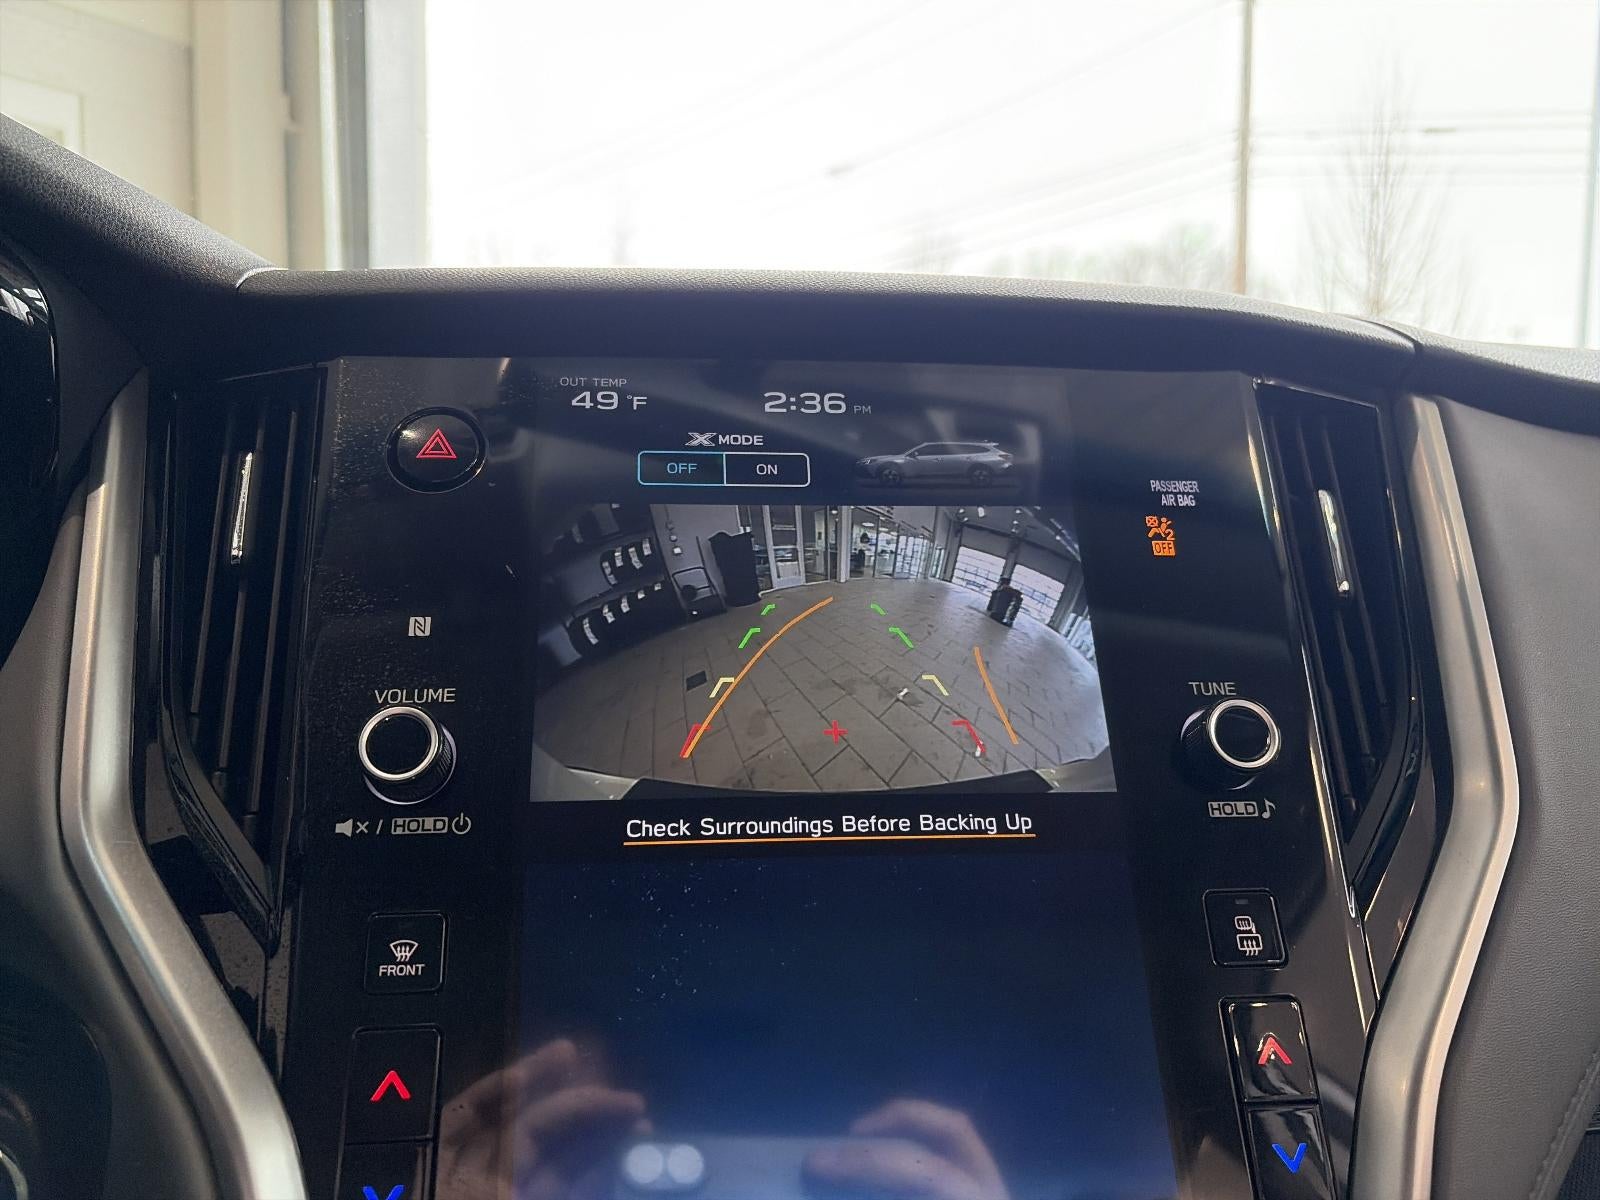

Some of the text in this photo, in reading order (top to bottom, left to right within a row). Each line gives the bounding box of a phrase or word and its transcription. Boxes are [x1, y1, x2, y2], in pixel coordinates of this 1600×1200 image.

[560, 377, 627, 387] OUT TEMP
[571, 391, 619, 410] 49
[763, 391, 872, 415] 2:36 PM
[718, 434, 764, 446] MODE
[666, 462, 698, 475] OFF
[756, 463, 778, 476] ON
[1150, 480, 1200, 493] PASSENGER
[1161, 494, 1196, 506] AIR BAG
[1154, 542, 1174, 554] OFF
[1188, 681, 1237, 696] TUNE
[374, 688, 456, 704] VOLUME
[1209, 803, 1256, 816] HOLD
[392, 818, 448, 834] HOLD
[626, 813, 1033, 838] Check Surroundings Before Backing Up
[378, 964, 426, 977] FRONT
